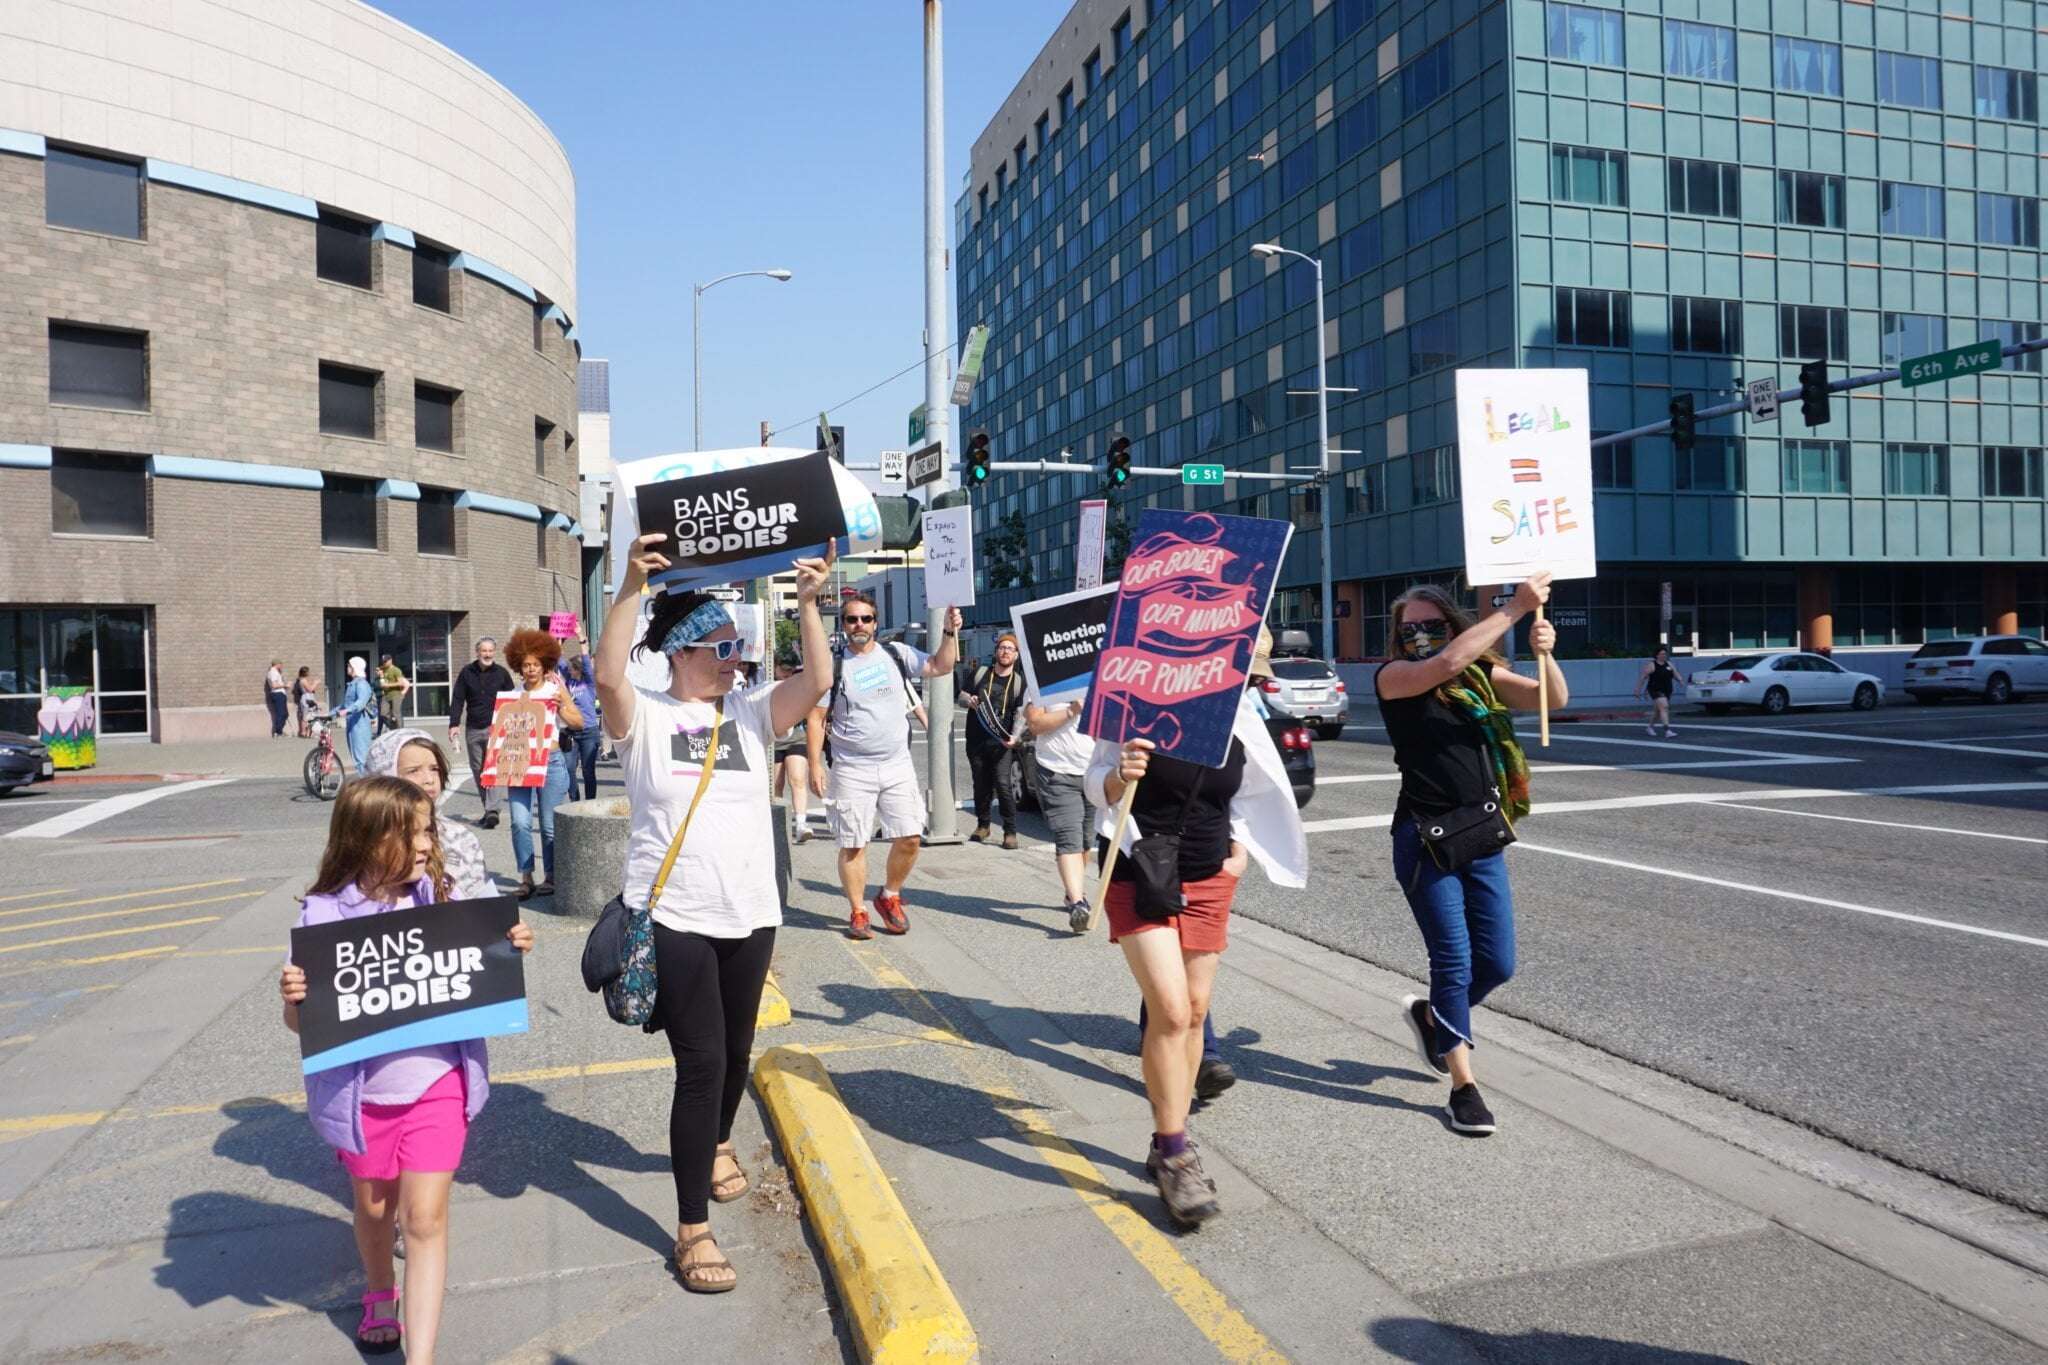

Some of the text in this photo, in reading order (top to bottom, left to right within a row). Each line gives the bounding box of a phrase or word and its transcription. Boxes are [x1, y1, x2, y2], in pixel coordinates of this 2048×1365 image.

[1911, 352, 1990, 379] 6th Ave
[1753, 381, 1771, 394] ONE
[1754, 393, 1772, 404] WAY
[1484, 397, 1571, 442] LEGAL
[885, 452, 903, 461] ONE
[885, 461, 903, 470] WAY
[915, 452, 939, 477] ONE WAY
[1189, 469, 1217, 480] G St
[673, 487, 750, 520] BANS
[674, 502, 799, 539] OFF OUR
[1490, 496, 1579, 545] SAFE
[678, 525, 788, 557] BODIES
[1124, 560, 1165, 586] OUR
[1163, 548, 1224, 577] BODIES
[1142, 600, 1245, 633] OUR MINDS
[1043, 622, 1107, 647] Abortion
[1045, 640, 1094, 663] Health
[1101, 656, 1227, 695] OUR POWER
[335, 927, 424, 969] BANS
[333, 946, 485, 994] OFF OUR
[337, 973, 472, 1022] BODIES
